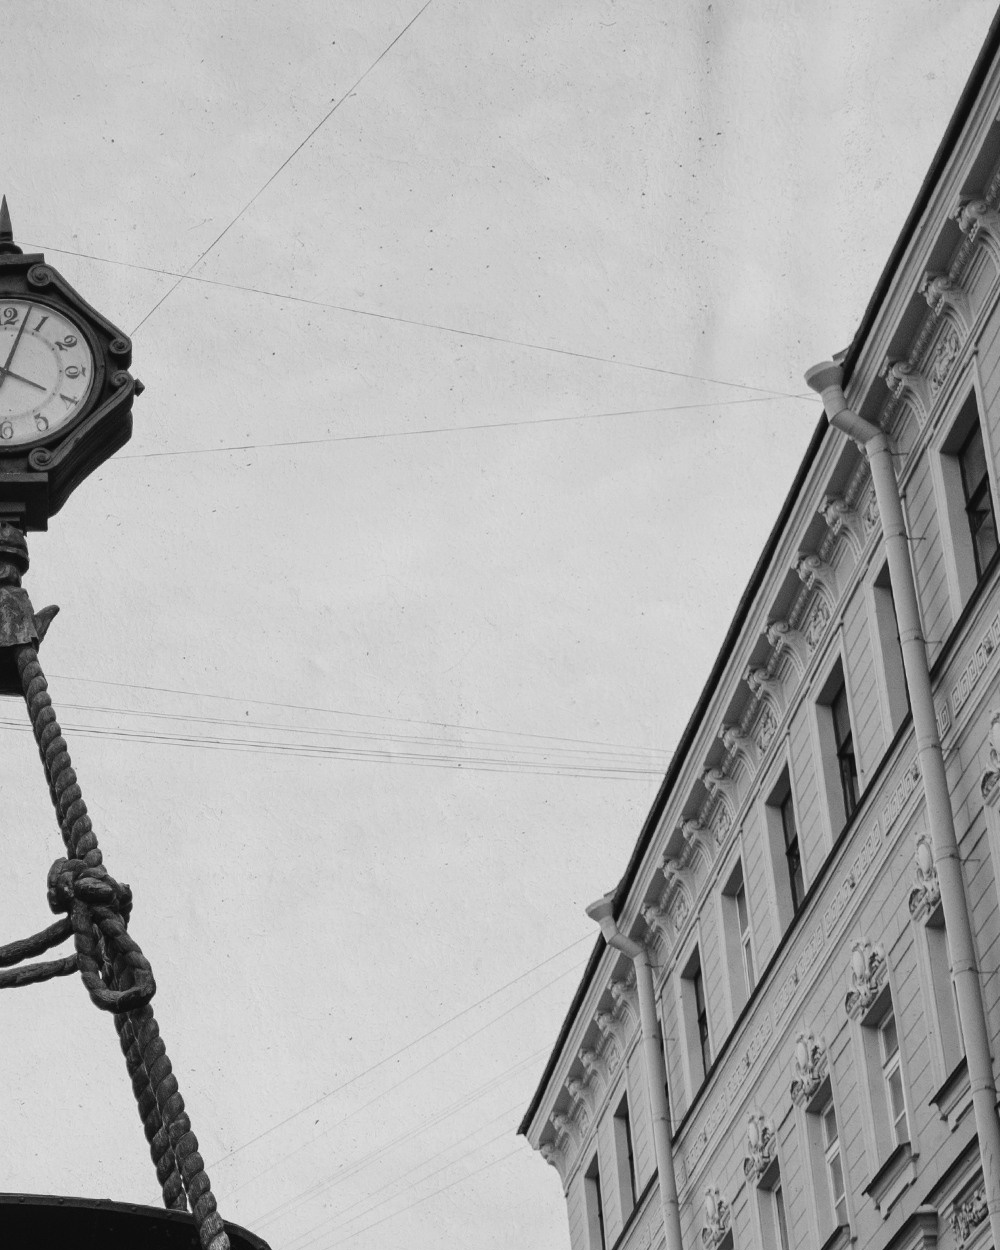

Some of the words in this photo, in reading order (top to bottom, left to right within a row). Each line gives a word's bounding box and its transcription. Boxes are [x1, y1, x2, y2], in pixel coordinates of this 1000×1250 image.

[33, 316, 49, 332] 1
[55, 335, 77, 351] 2
[65, 365, 86, 379] 3
[60, 393, 80, 410] 4
[34, 413, 50, 433] 5
